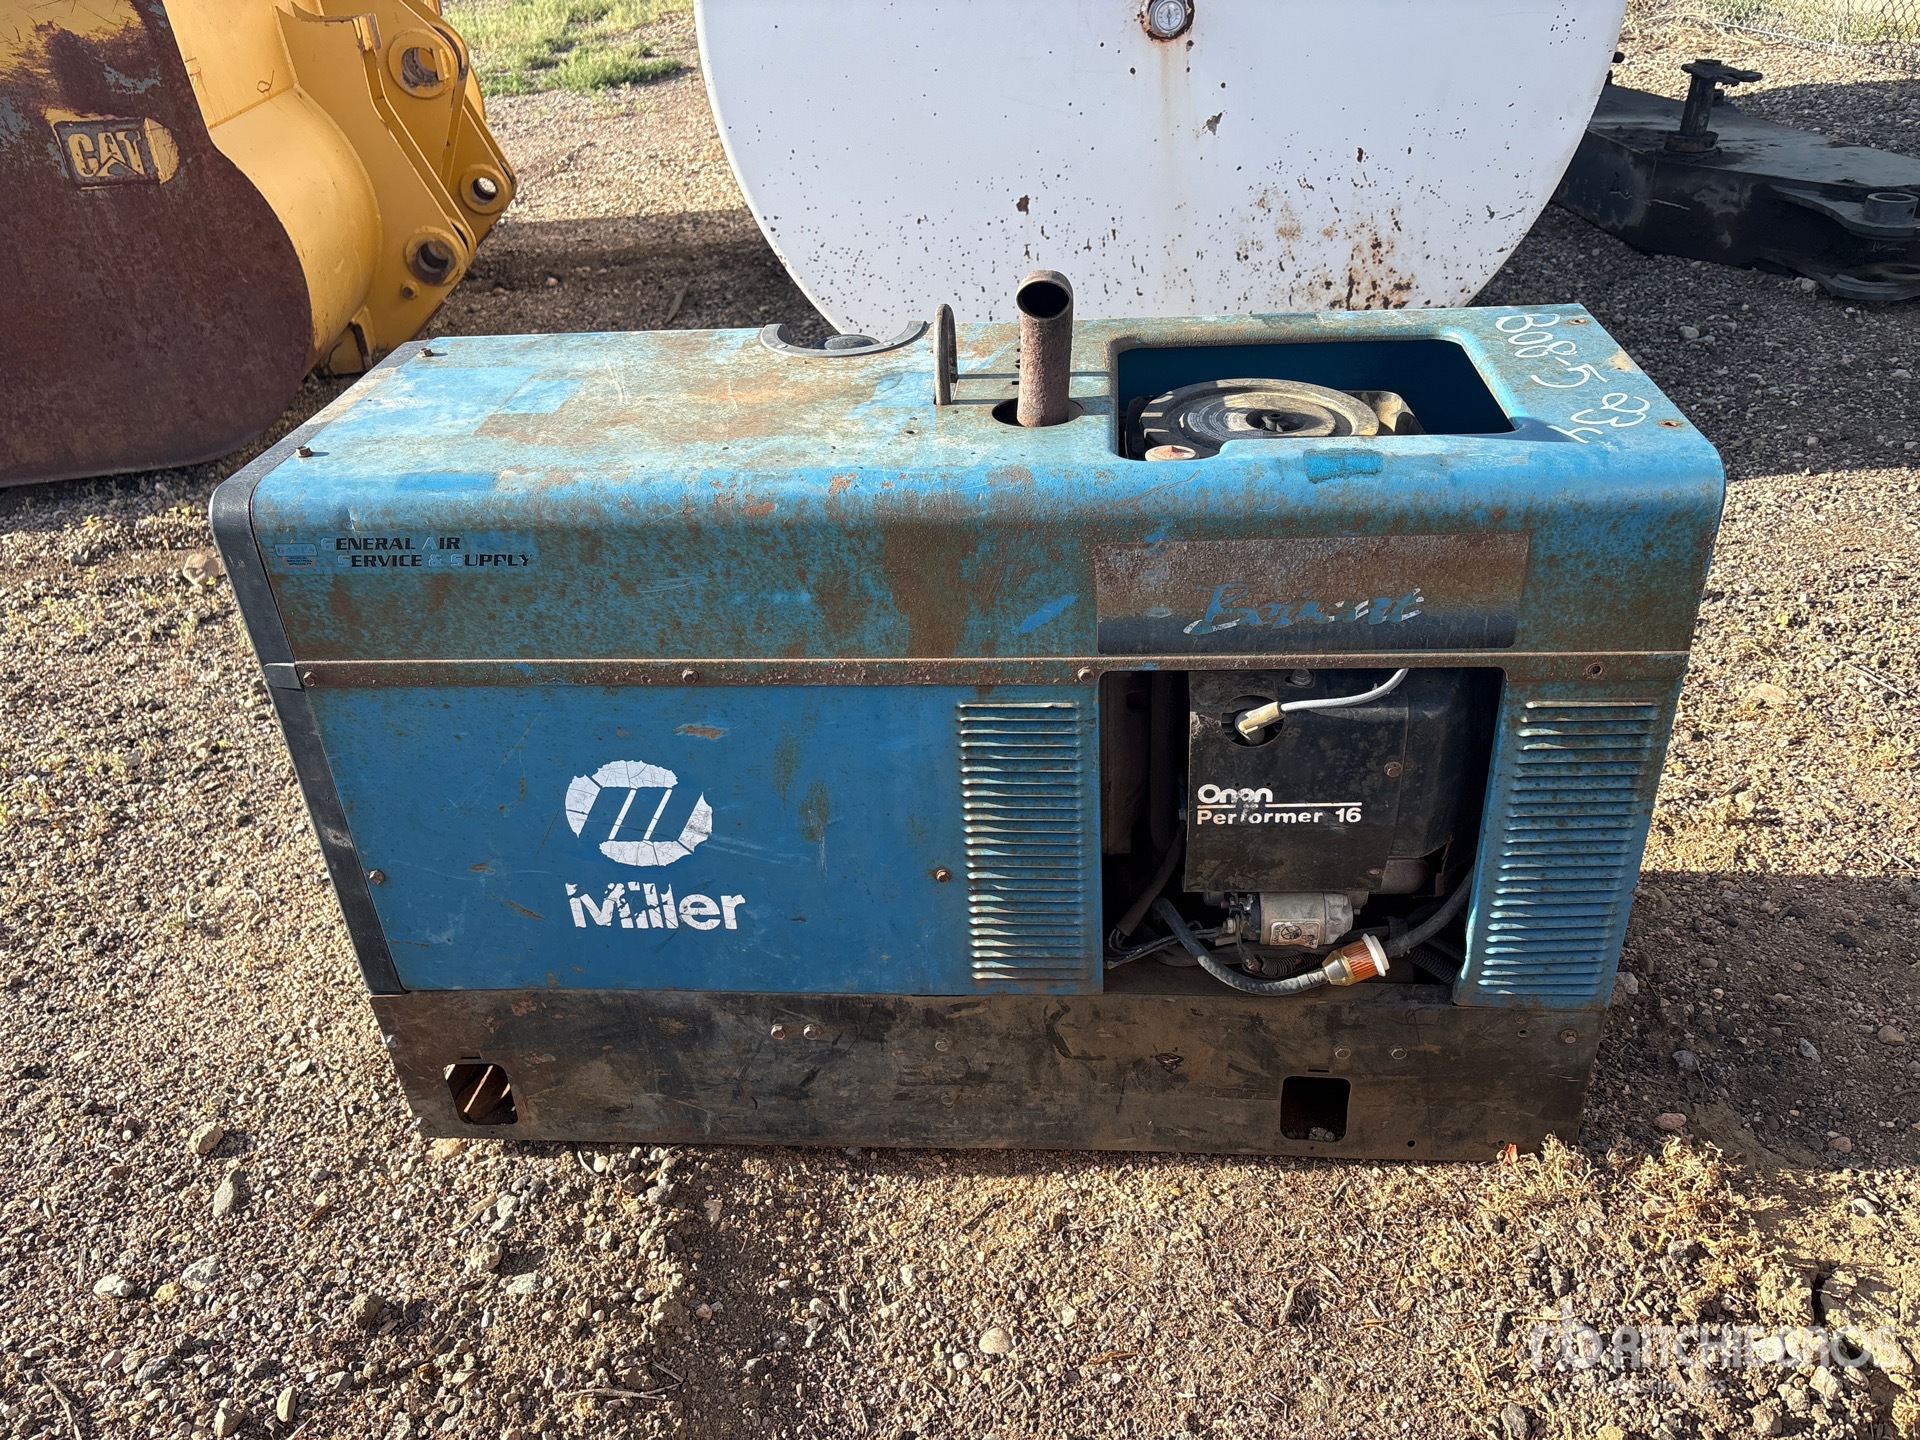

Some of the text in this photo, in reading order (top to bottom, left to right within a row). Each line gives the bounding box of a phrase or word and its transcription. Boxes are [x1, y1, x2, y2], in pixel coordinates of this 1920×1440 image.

[67, 130, 145, 178] CAT
[320, 536, 416, 551] GENERAL
[421, 535, 461, 551] AIR
[337, 554, 422, 568] SERVICE
[450, 553, 532, 567] SUPPLY
[1197, 783, 1273, 804] Onan
[1335, 807, 1362, 823] 16
[564, 881, 746, 931] Miller
